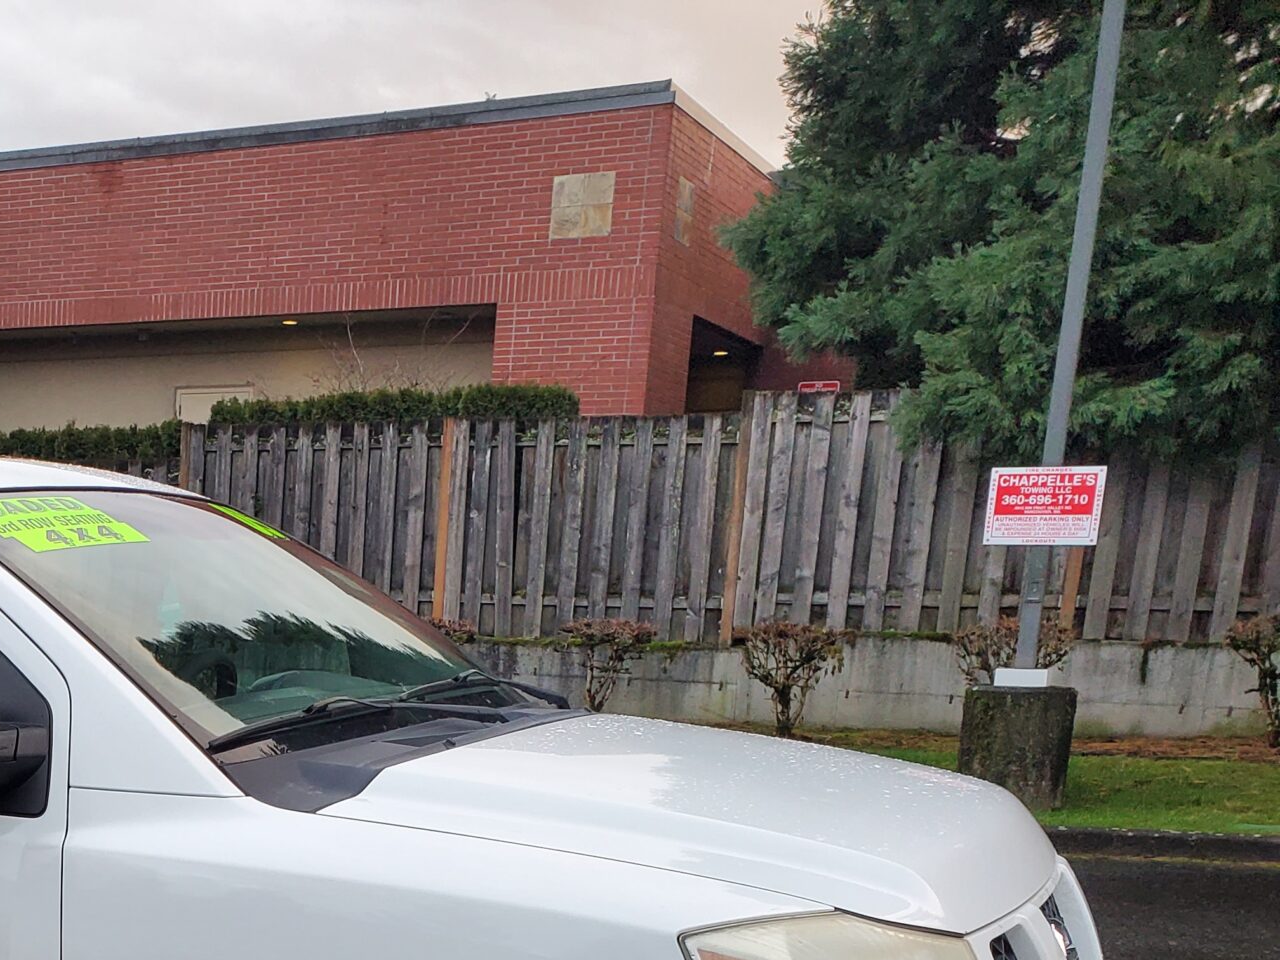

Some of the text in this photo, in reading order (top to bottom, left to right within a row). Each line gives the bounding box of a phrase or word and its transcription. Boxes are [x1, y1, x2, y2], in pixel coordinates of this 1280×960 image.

[1000, 475, 1096, 487] CHAPPELLE'S
[1020, 486, 1072, 494] TOWING LLC
[1001, 494, 1089, 505] 360-696-1710
[18, 517, 59, 531] ROW
[57, 512, 113, 527] SEATING
